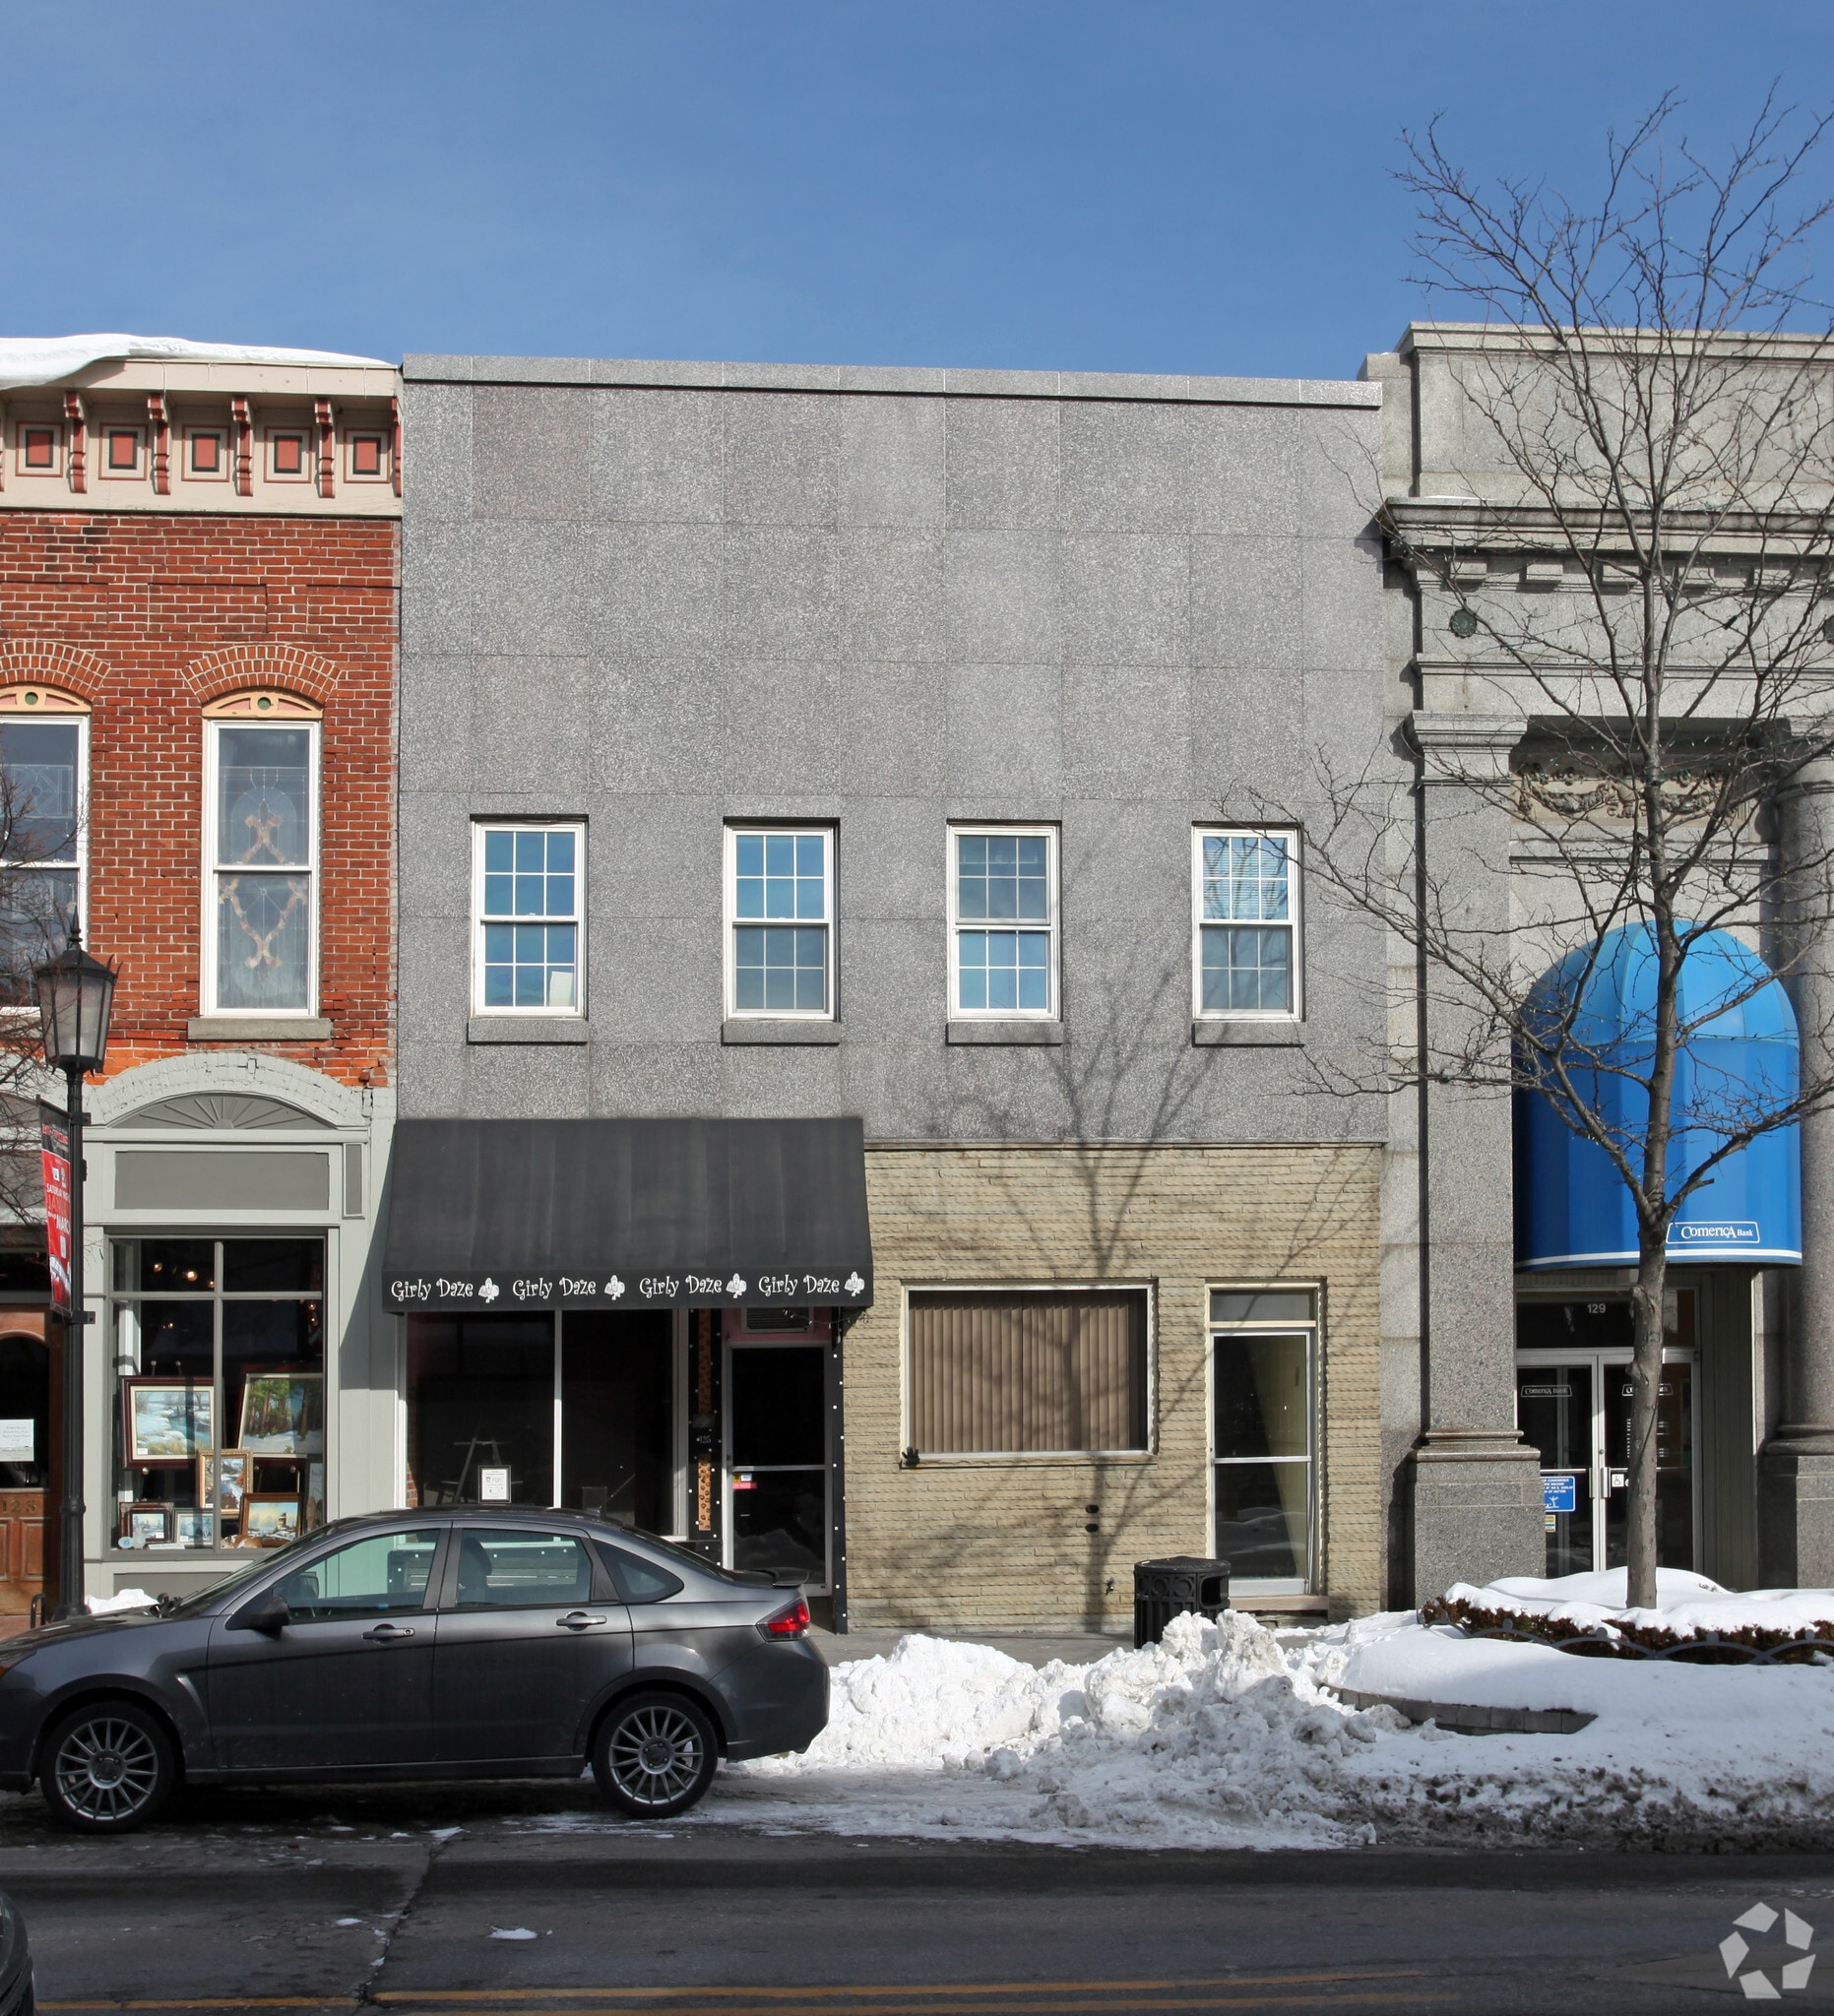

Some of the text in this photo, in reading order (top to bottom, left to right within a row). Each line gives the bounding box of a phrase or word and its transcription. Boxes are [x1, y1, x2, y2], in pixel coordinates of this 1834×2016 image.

[391, 1274, 840, 1301] Girly Daze Girly Daze Girly Daze Girly Daze
[1587, 1303, 1607, 1314] 129
